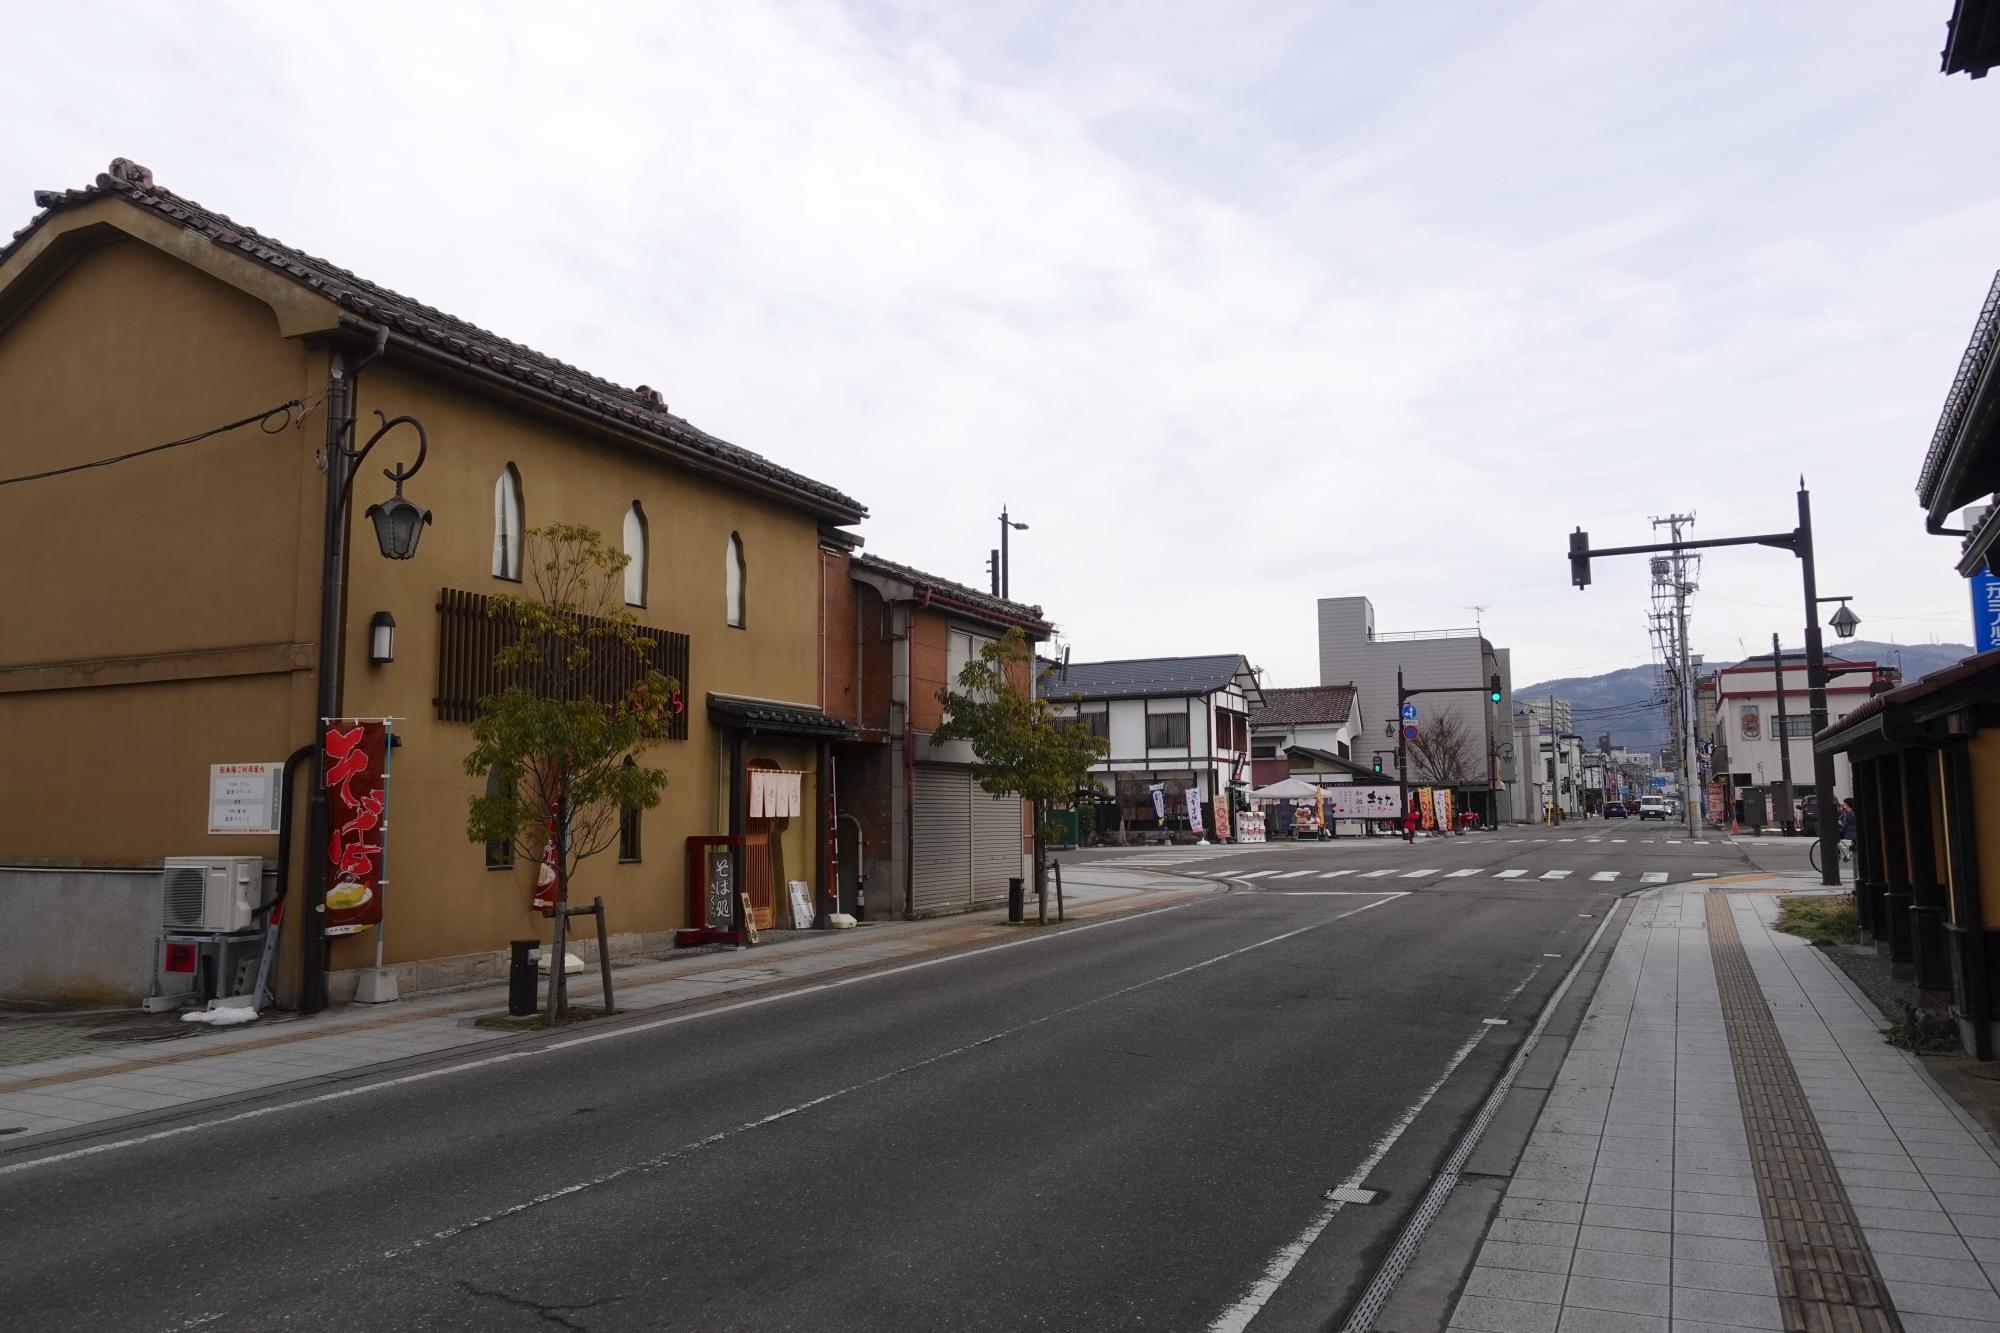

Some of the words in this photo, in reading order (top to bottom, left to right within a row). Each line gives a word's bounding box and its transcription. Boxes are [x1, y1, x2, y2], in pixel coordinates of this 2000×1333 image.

[715, 859, 730, 918] そば処
[173, 945, 189, 972] P
